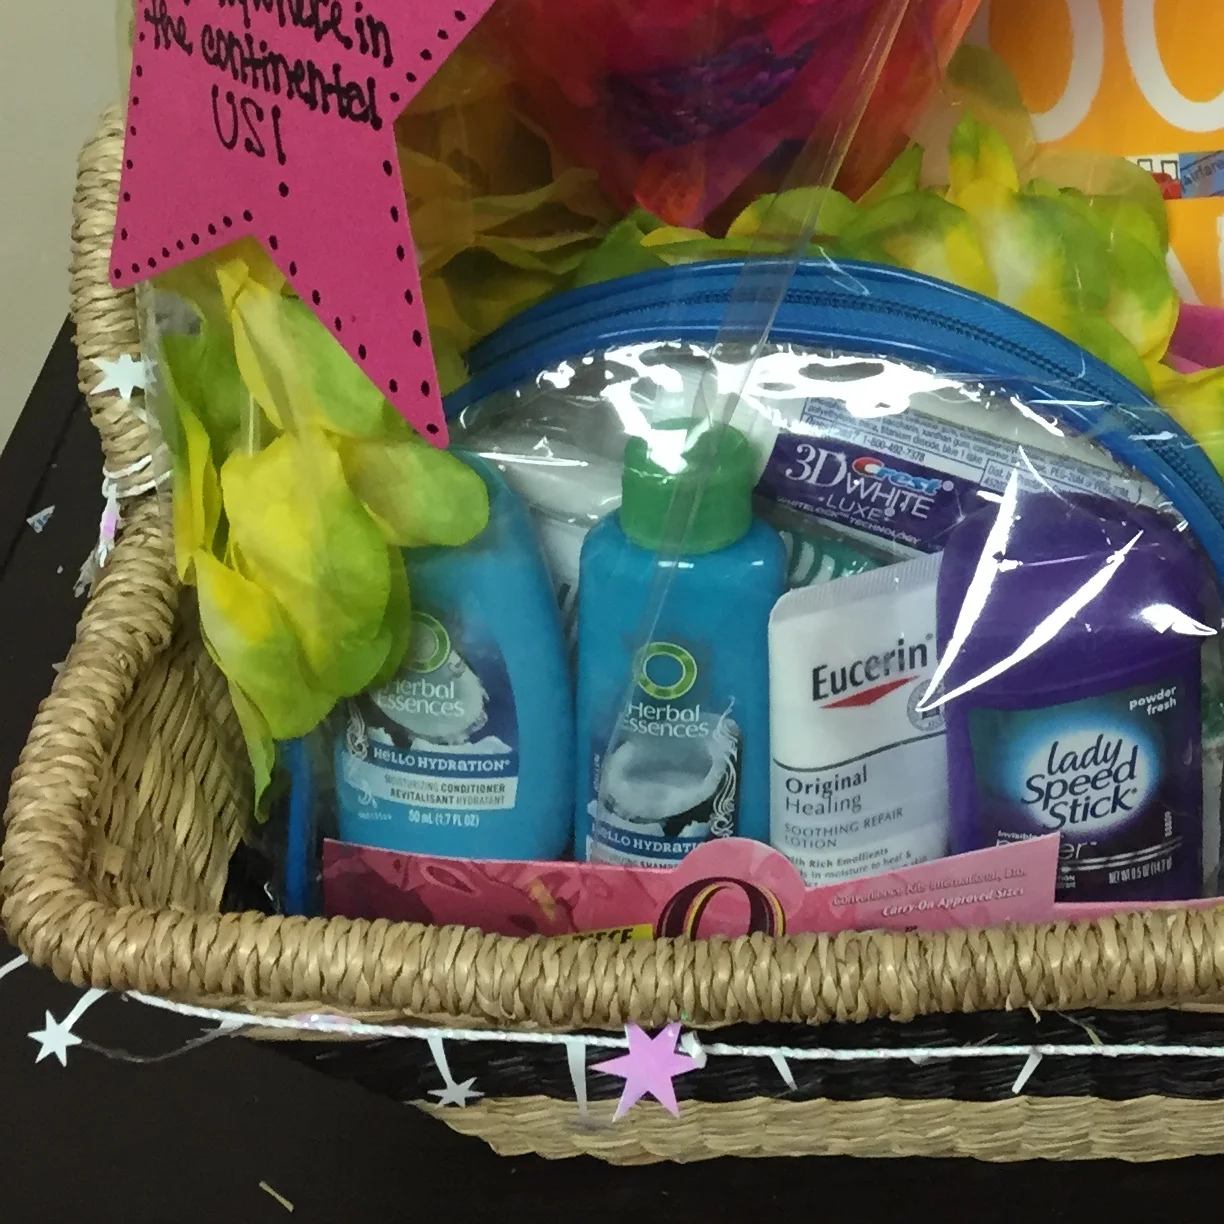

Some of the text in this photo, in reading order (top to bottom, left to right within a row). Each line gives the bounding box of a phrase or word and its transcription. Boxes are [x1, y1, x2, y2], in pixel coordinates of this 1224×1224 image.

[355, 1, 394, 67] in
[212, 84, 290, 197] US!
[786, 444, 847, 487] 3D
[852, 457, 943, 496] Crest
[826, 494, 884, 523] LUXE
[846, 472, 935, 519] WHITE
[812, 638, 928, 701] Eucerin
[627, 702, 700, 722] Herbal
[1129, 686, 1177, 711] powder
[1146, 697, 1177, 716] fresh
[1047, 734, 1123, 776] lady
[440, 781, 506, 794] CONDITIONER
[785, 764, 868, 799] Original
[1020, 744, 1139, 811] Speed
[785, 794, 862, 816] Healing
[1042, 784, 1133, 829] Stick
[784, 807, 904, 839] SOOTHING REPAIR
[784, 835, 838, 850] LOTION
[809, 858, 833, 869] Rich
[837, 847, 889, 867] Emollients
[937, 888, 992, 909] Approved
[994, 886, 1025, 899] Sizes
